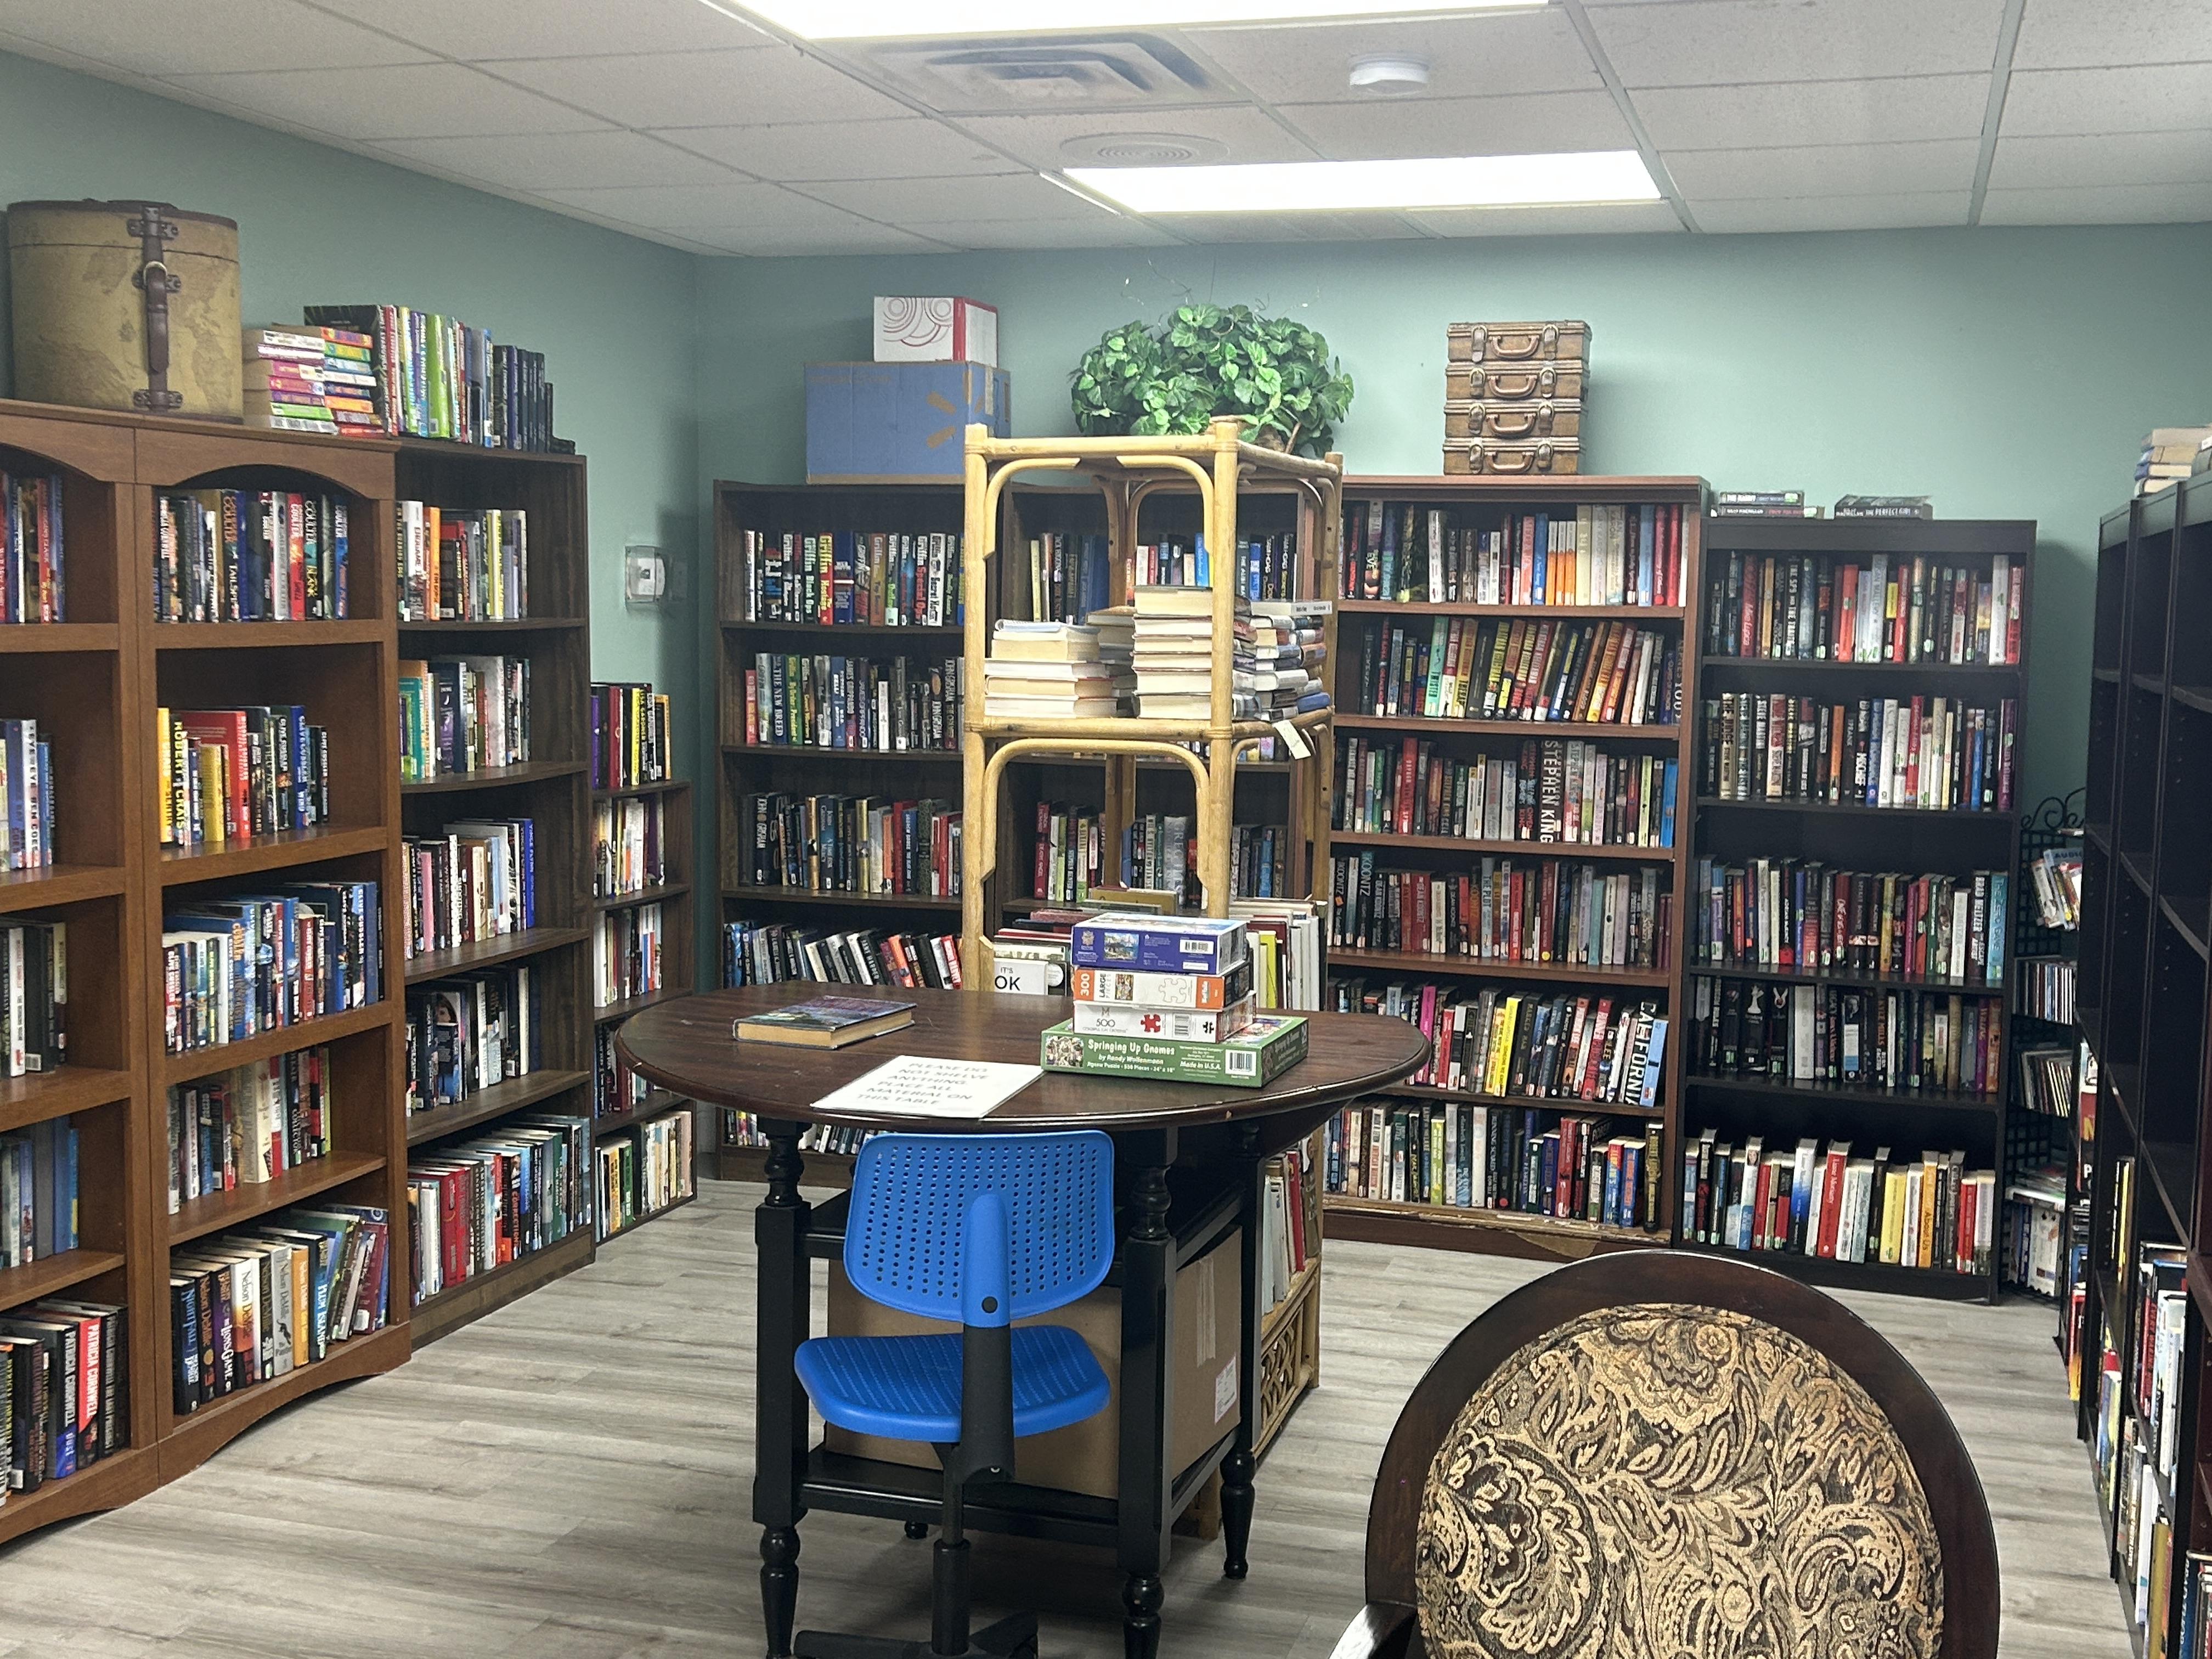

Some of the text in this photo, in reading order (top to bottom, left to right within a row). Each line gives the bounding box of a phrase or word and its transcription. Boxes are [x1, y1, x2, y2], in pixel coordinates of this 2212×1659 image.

[1540, 741, 1558, 843] STEPHEN KING
[995, 976, 1020, 991] OK
[1080, 974, 1090, 996] 300
[1088, 1039, 1127, 1053] Springing
[1130, 1042, 1141, 1054] Up
[65, 1331, 75, 1426] PATRICIA CORNWELL
[86, 1324, 99, 1418] PATRICIA CORNWELL
